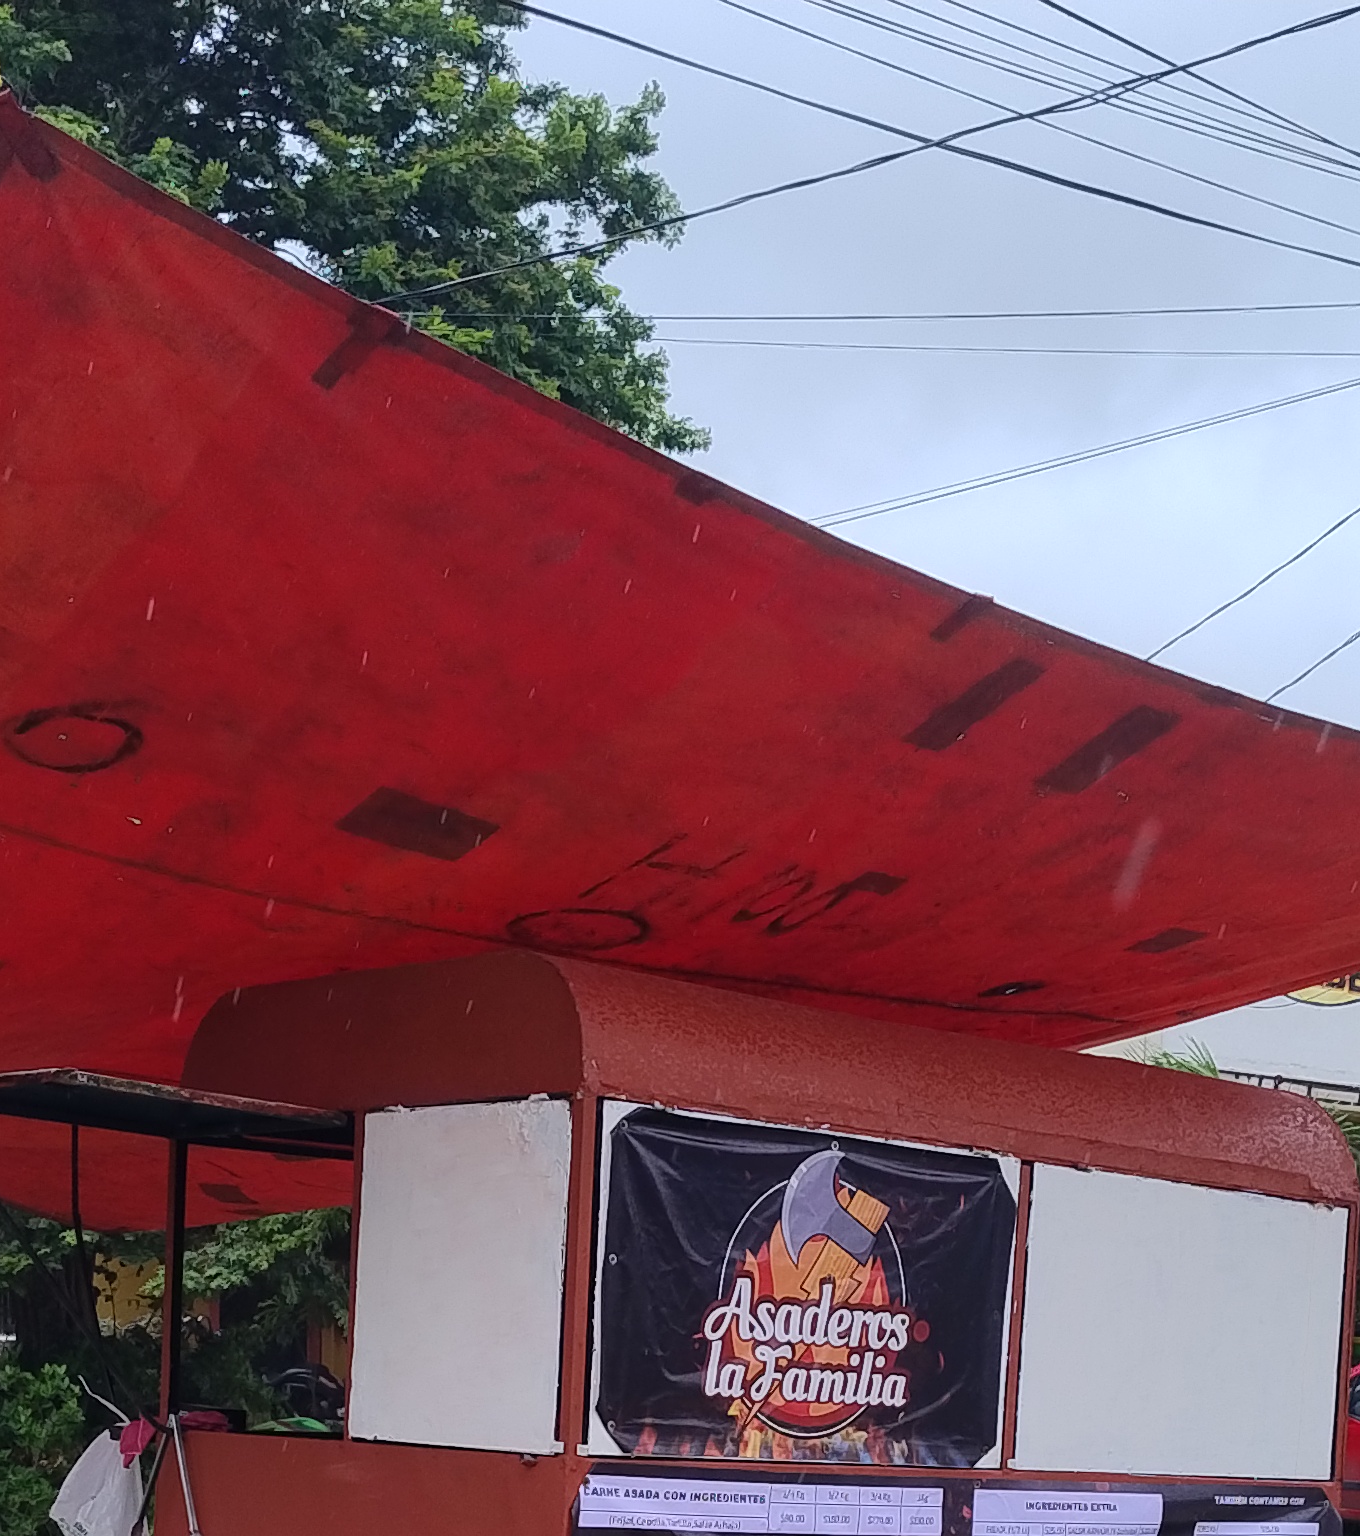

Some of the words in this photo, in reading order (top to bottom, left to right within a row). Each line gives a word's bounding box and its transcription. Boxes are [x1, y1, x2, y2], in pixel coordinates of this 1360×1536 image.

[704, 1278, 910, 1350] Asaderos
[705, 1340, 746, 1397] la
[750, 1344, 907, 1407] Familia
[584, 1486, 620, 1498] CARNE
[624, 1488, 659, 1500] ASADA
[664, 1489, 686, 1501] CON
[690, 1491, 766, 1504] INGREDIENTES
[1025, 1502, 1088, 1512] INGREDIENTES
[1091, 1503, 1118, 1512] EXTRA
